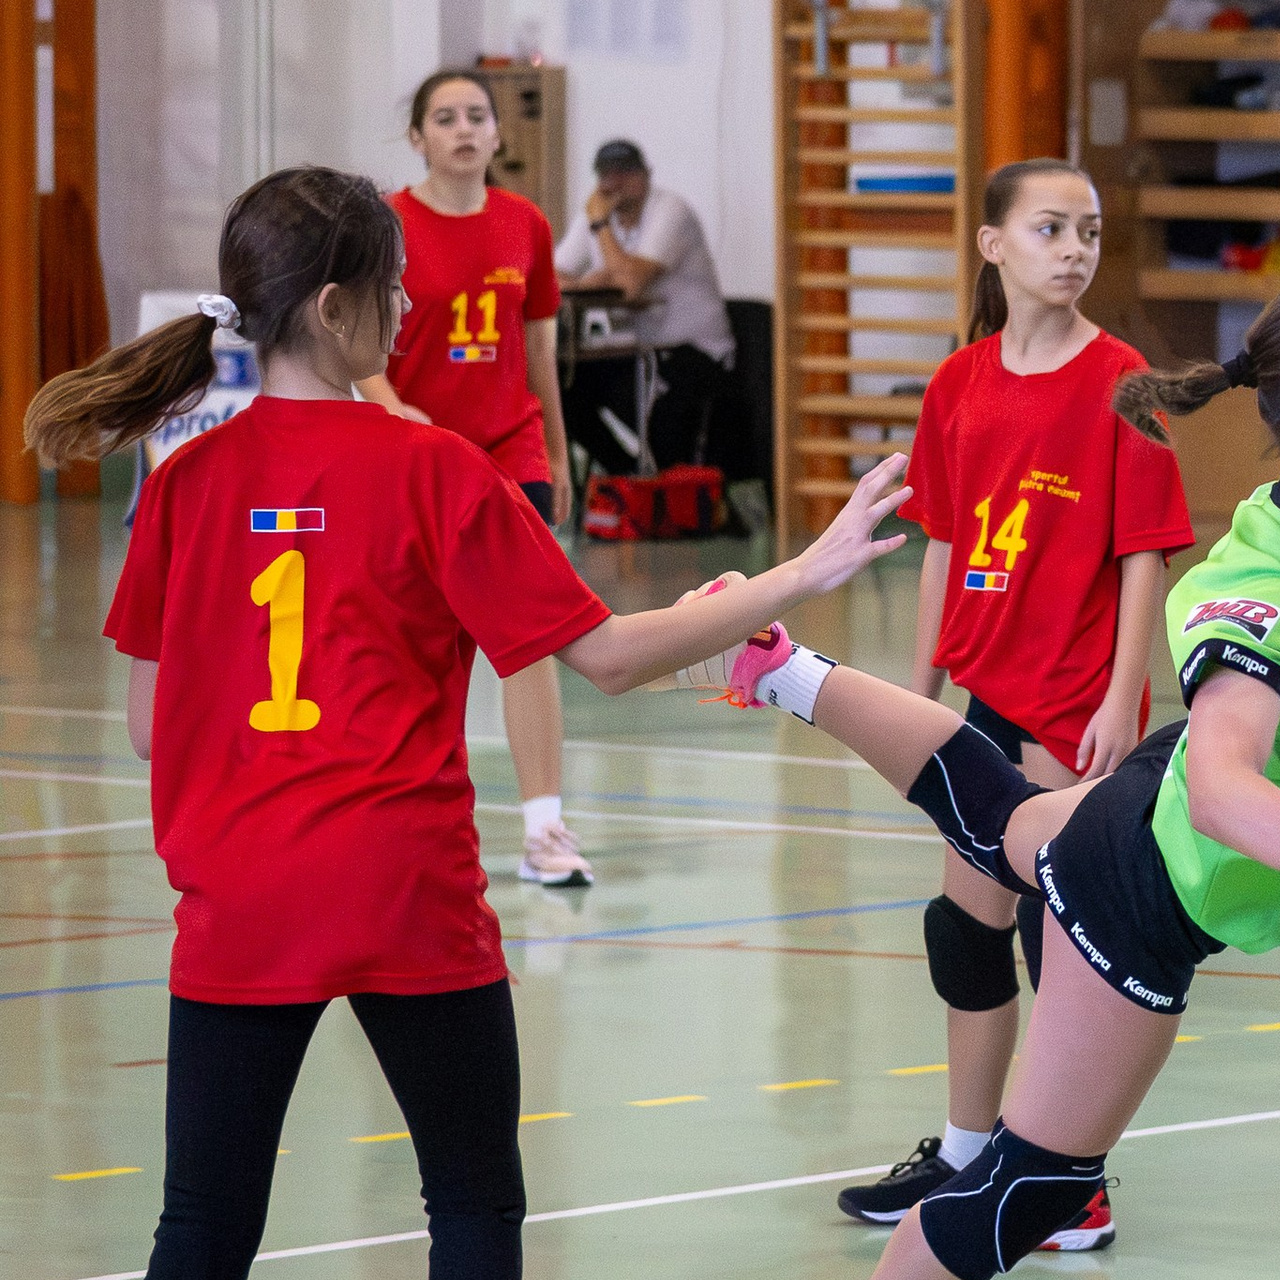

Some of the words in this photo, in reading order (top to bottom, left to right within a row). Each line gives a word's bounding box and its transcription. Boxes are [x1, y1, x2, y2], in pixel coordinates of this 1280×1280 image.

[448, 289, 500, 344] 11
[968, 496, 1029, 571] 14
[249, 549, 321, 732] 1
[1221, 644, 1269, 676] Kempa
[1039, 863, 1066, 915] Kempa
[1070, 922, 1112, 972] Kempa
[1123, 976, 1174, 1008] Kempa
